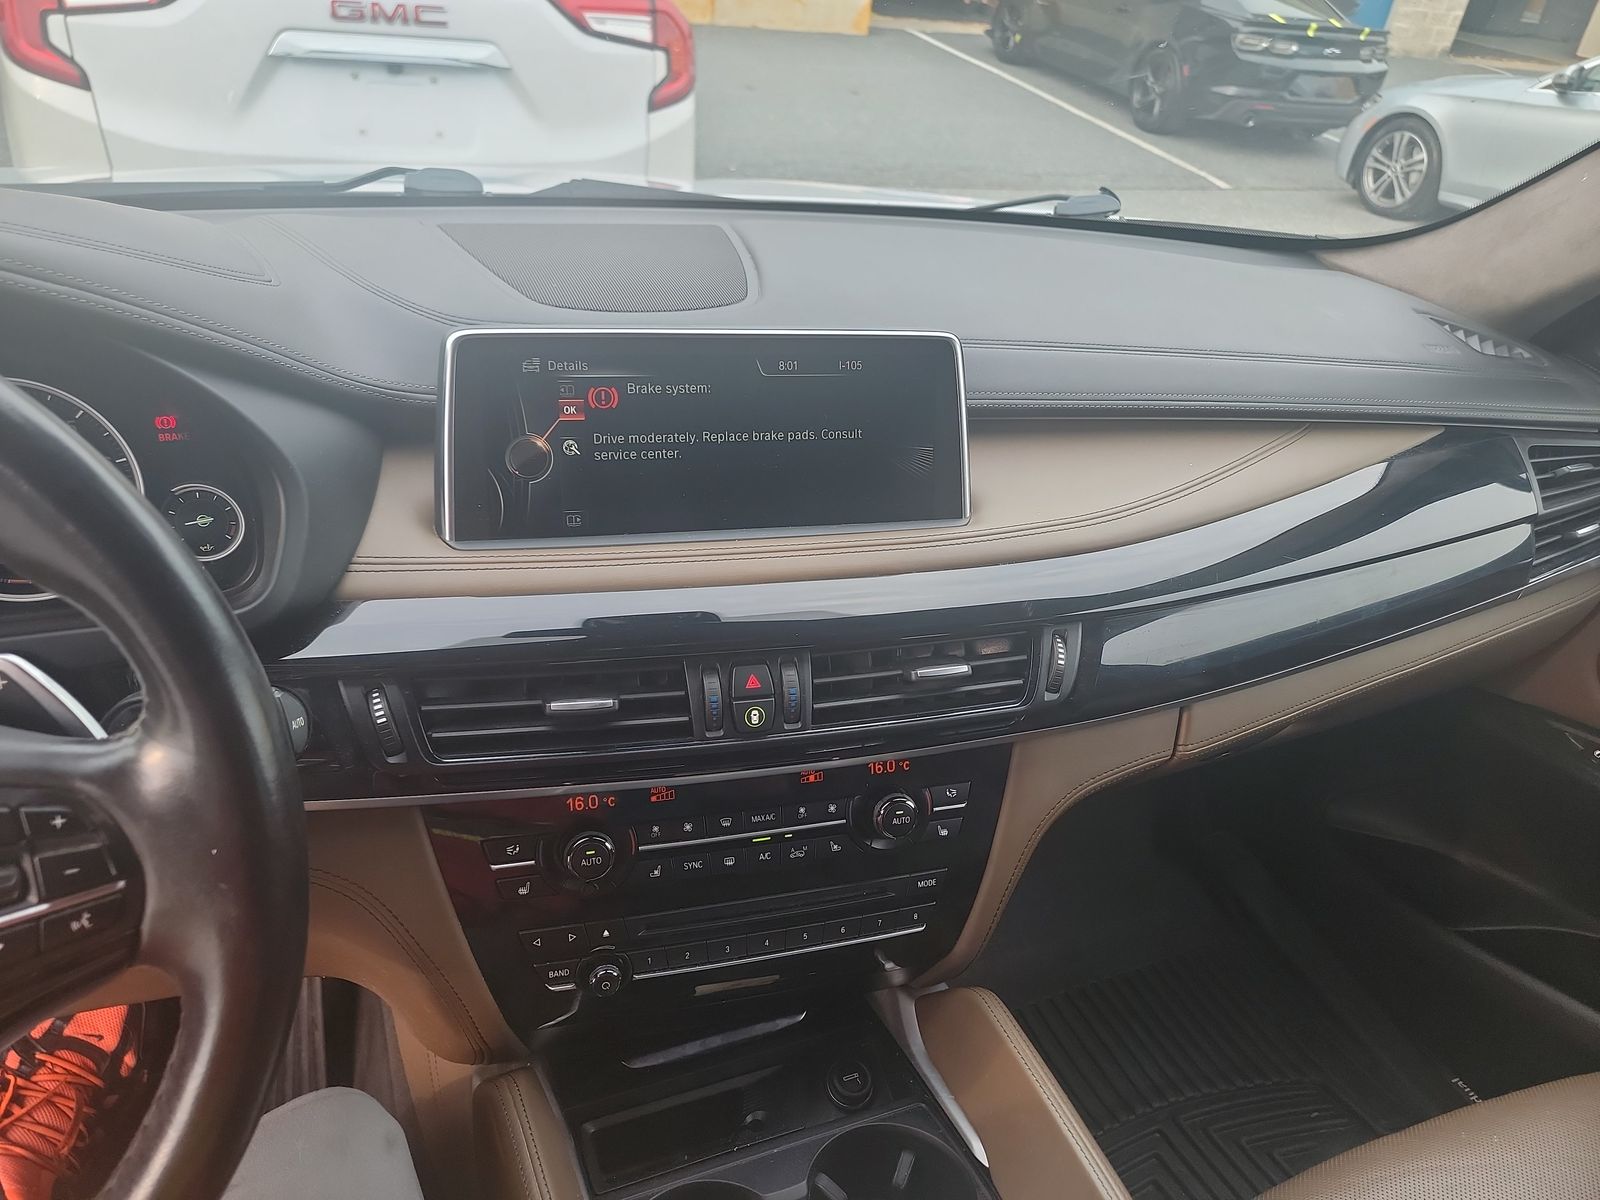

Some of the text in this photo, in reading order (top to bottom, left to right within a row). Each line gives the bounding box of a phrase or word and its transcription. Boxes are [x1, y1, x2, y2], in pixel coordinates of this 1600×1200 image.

[330, 0, 448, 27] GMC
[548, 360, 589, 372] Details
[778, 360, 799, 371] 8:01
[627, 382, 711, 397] Brake system:
[563, 405, 577, 415] OK
[158, 432, 191, 442] BRAKE
[593, 428, 863, 447] Drive moderately. Replace brake pads. Consult
[594, 449, 682, 461] service center.
[868, 760, 896, 775] 16.0
[566, 795, 599, 811] 16.0
[892, 816, 911, 825] AUTO
[759, 851, 771, 861] A/C
[580, 856, 602, 867] AUTO
[683, 860, 703, 871] SYNC
[917, 878, 937, 888] MODE
[913, 912, 919, 920] 8
[877, 919, 882, 927] 7
[840, 926, 846, 934] 6
[803, 932, 808, 941] 5
[764, 938, 769, 947] 4
[725, 945, 730, 954] 3
[684, 951, 690, 960] 2
[548, 968, 570, 979] BAND
